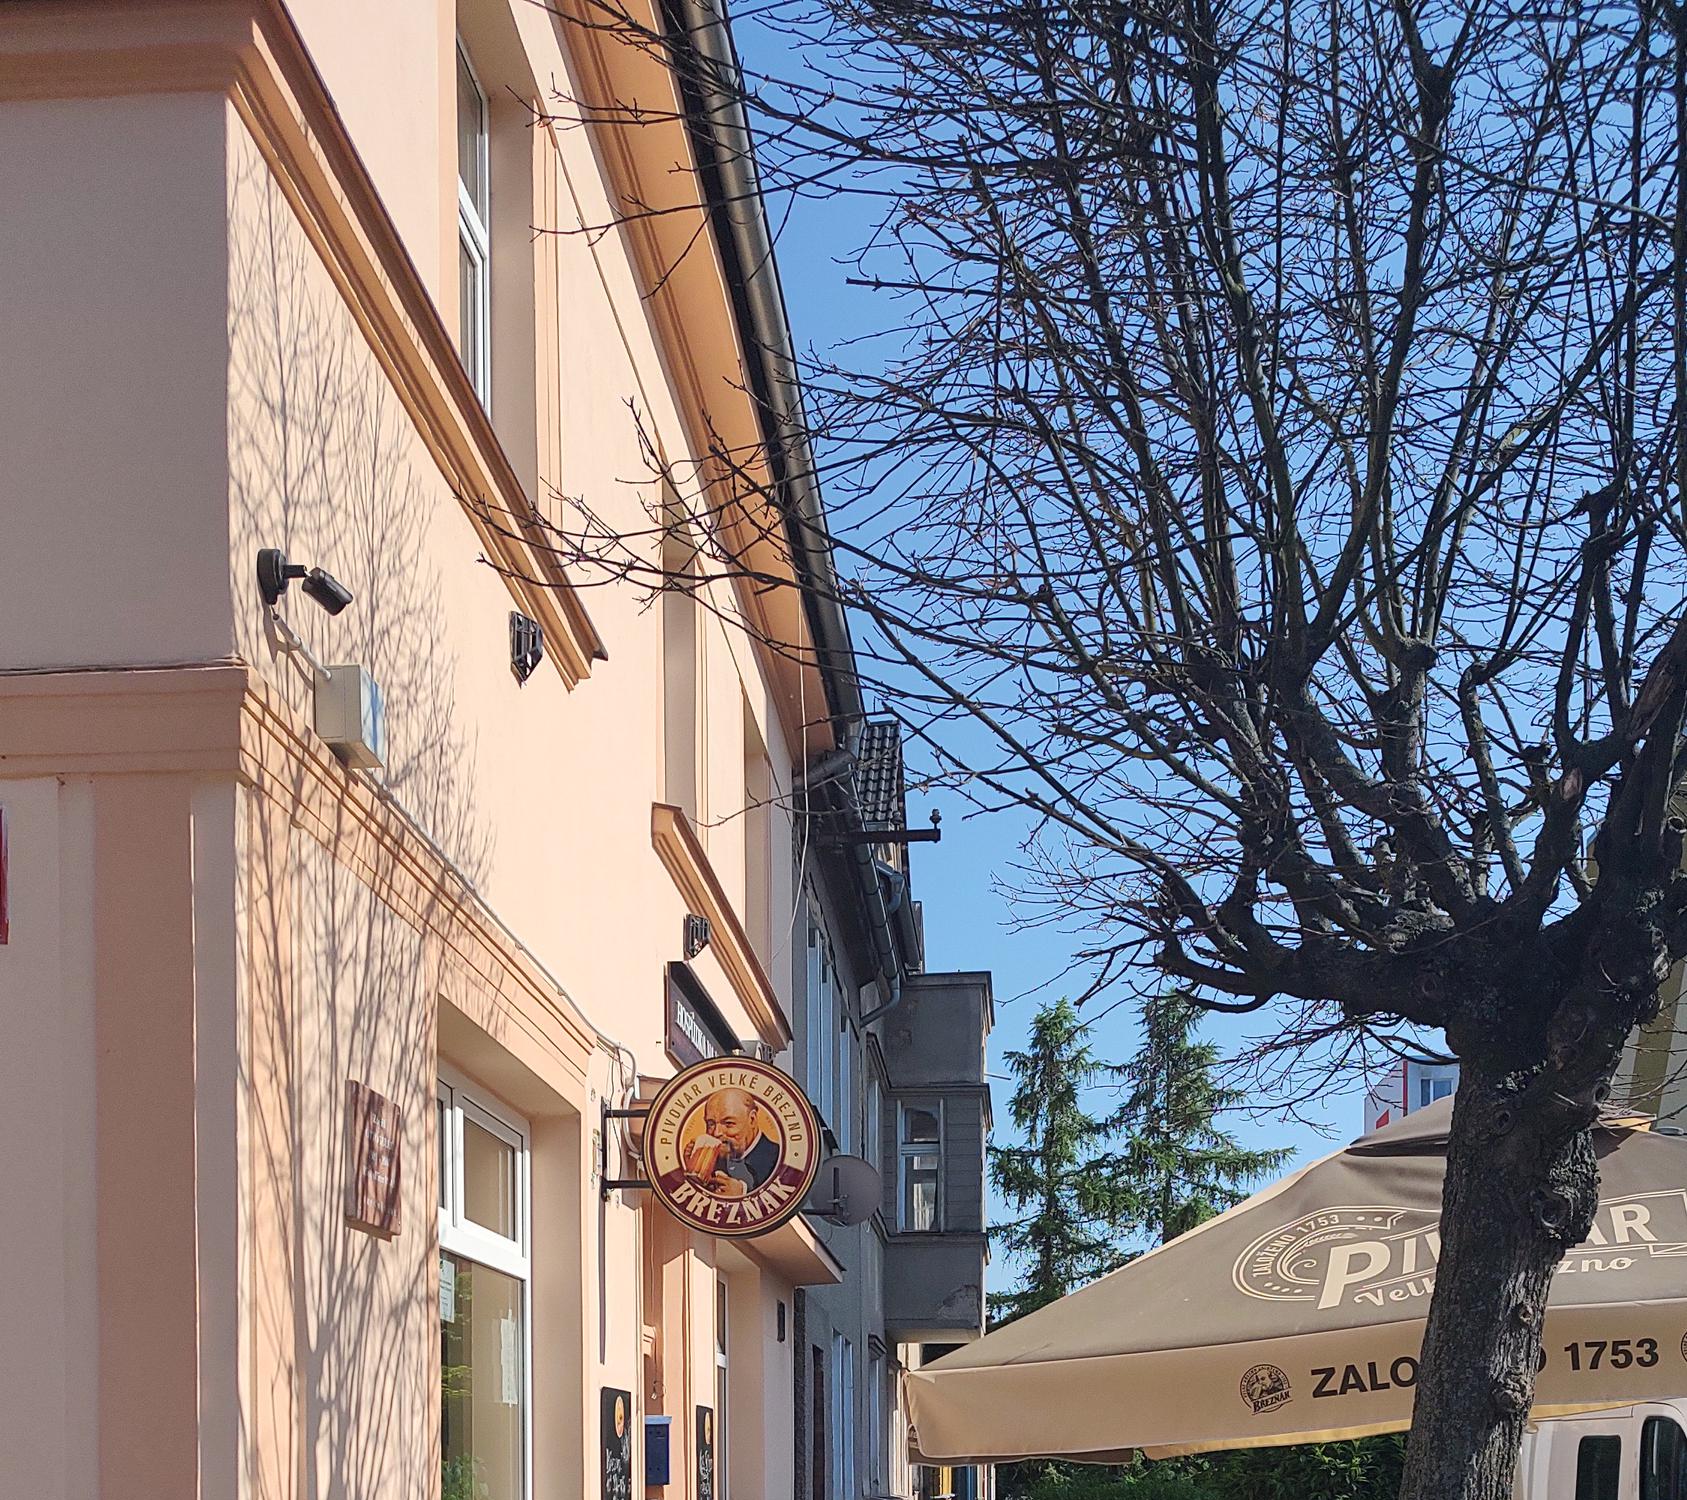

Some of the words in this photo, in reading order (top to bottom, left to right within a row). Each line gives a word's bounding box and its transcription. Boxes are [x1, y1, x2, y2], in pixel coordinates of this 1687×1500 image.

[660, 1083, 703, 1145] PIVOVAR
[708, 1073, 759, 1090] VELKÉ
[763, 1085, 803, 1142] BŘEZNO
[669, 1175, 797, 1225] BŘEZŇÁK
[1252, 1234, 1297, 1278] ZALOŽENO
[1296, 1214, 1340, 1234] 1753
[1564, 1337, 1660, 1371] 1753
